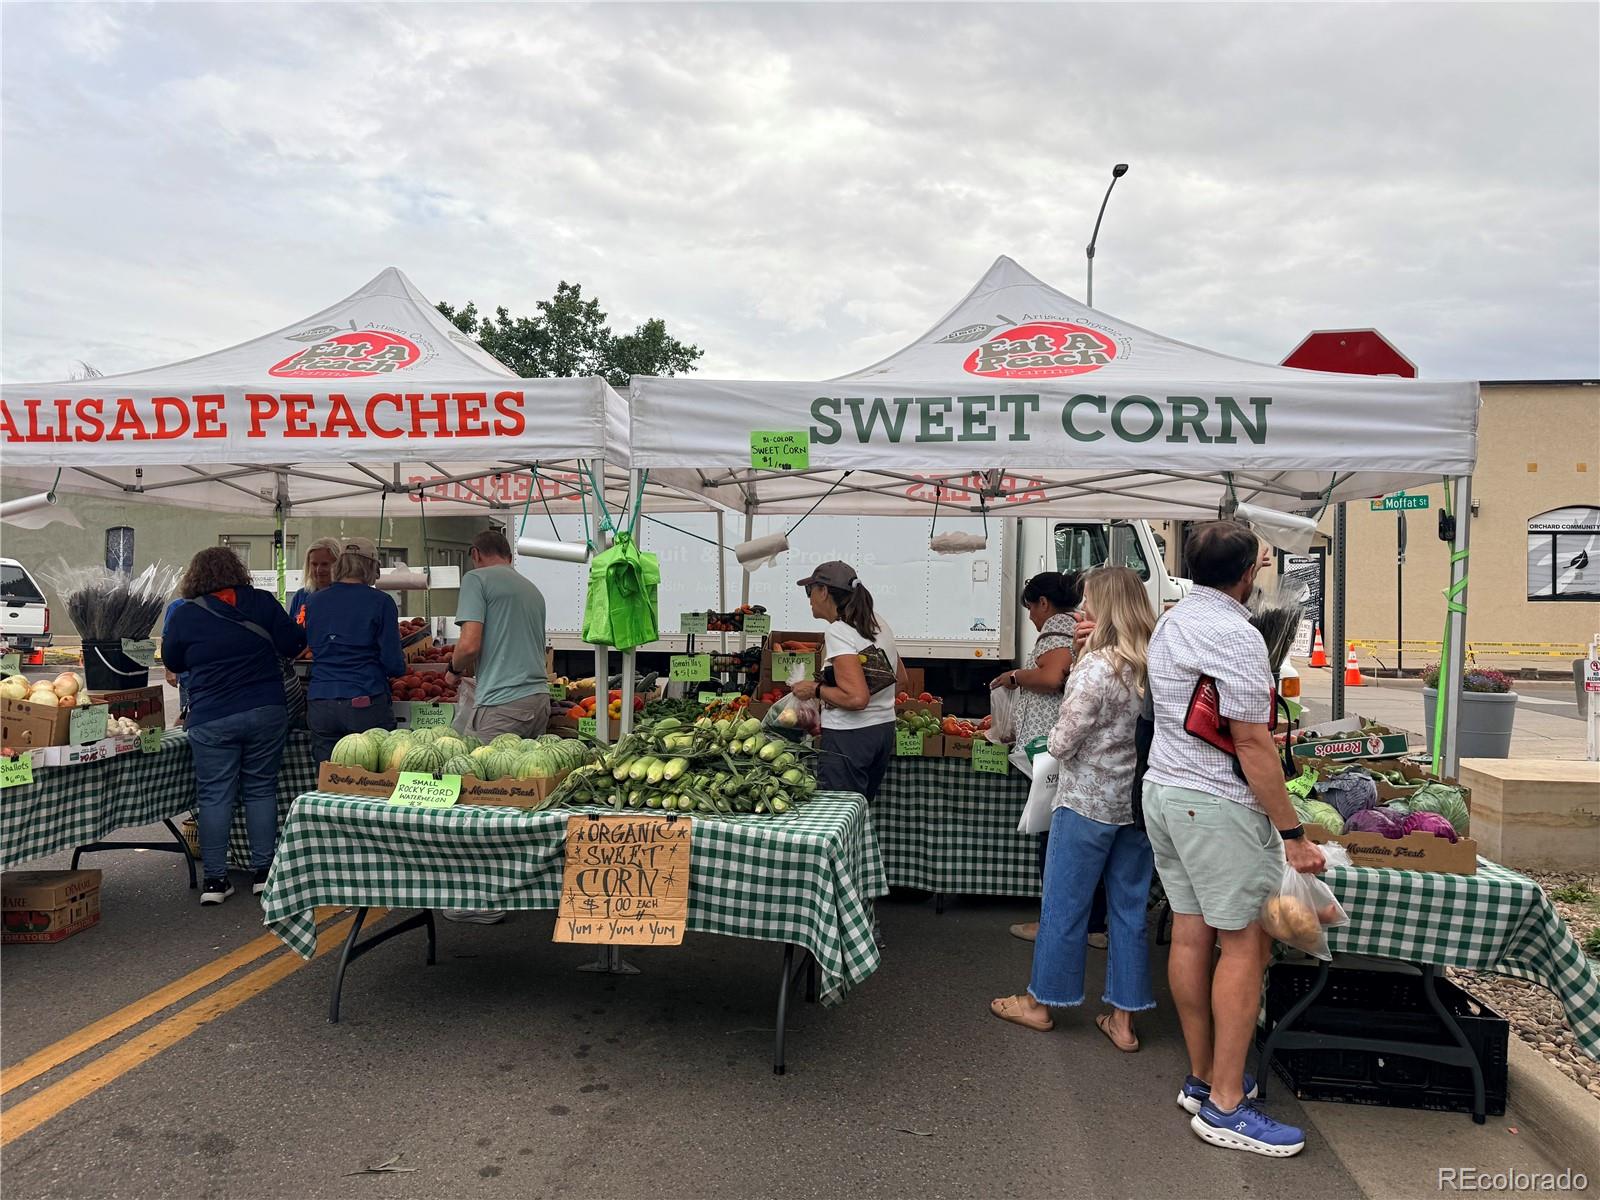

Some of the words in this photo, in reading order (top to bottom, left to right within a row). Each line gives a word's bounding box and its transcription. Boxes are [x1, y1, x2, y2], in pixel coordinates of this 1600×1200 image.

[300, 342, 371, 359] Eat
[370, 345, 409, 361] A
[980, 335, 1056, 358] Eat
[1061, 333, 1107, 351] A
[275, 358, 397, 373] Peach
[977, 350, 1110, 371] Peach
[1004, 368, 1075, 377] Farms
[245, 391, 526, 439] PEACHES
[809, 394, 1041, 445] SWEET
[1061, 393, 1273, 445] CORN
[752, 445, 780, 455] SWEET
[783, 443, 807, 455] CORN
[1385, 497, 1417, 509] Moffat
[1418, 498, 1428, 506] St
[416, 717, 447, 726] PEACHES
[1315, 740, 1363, 757] Remo's
[0, 761, 29, 774] Shallots
[328, 773, 355, 785] Rocky
[355, 776, 396, 788] Mountain
[412, 779, 439, 788] SMALL
[398, 784, 426, 794] ROCKY
[427, 787, 454, 797] FORD
[469, 785, 509, 796] Mountain
[399, 793, 447, 804] WATERMELON
[587, 820, 677, 844] ORGANIC
[584, 844, 665, 869] SWEET
[1345, 842, 1392, 856] Mountain
[1392, 846, 1426, 858] Fresh
[576, 867, 659, 898] CORN
